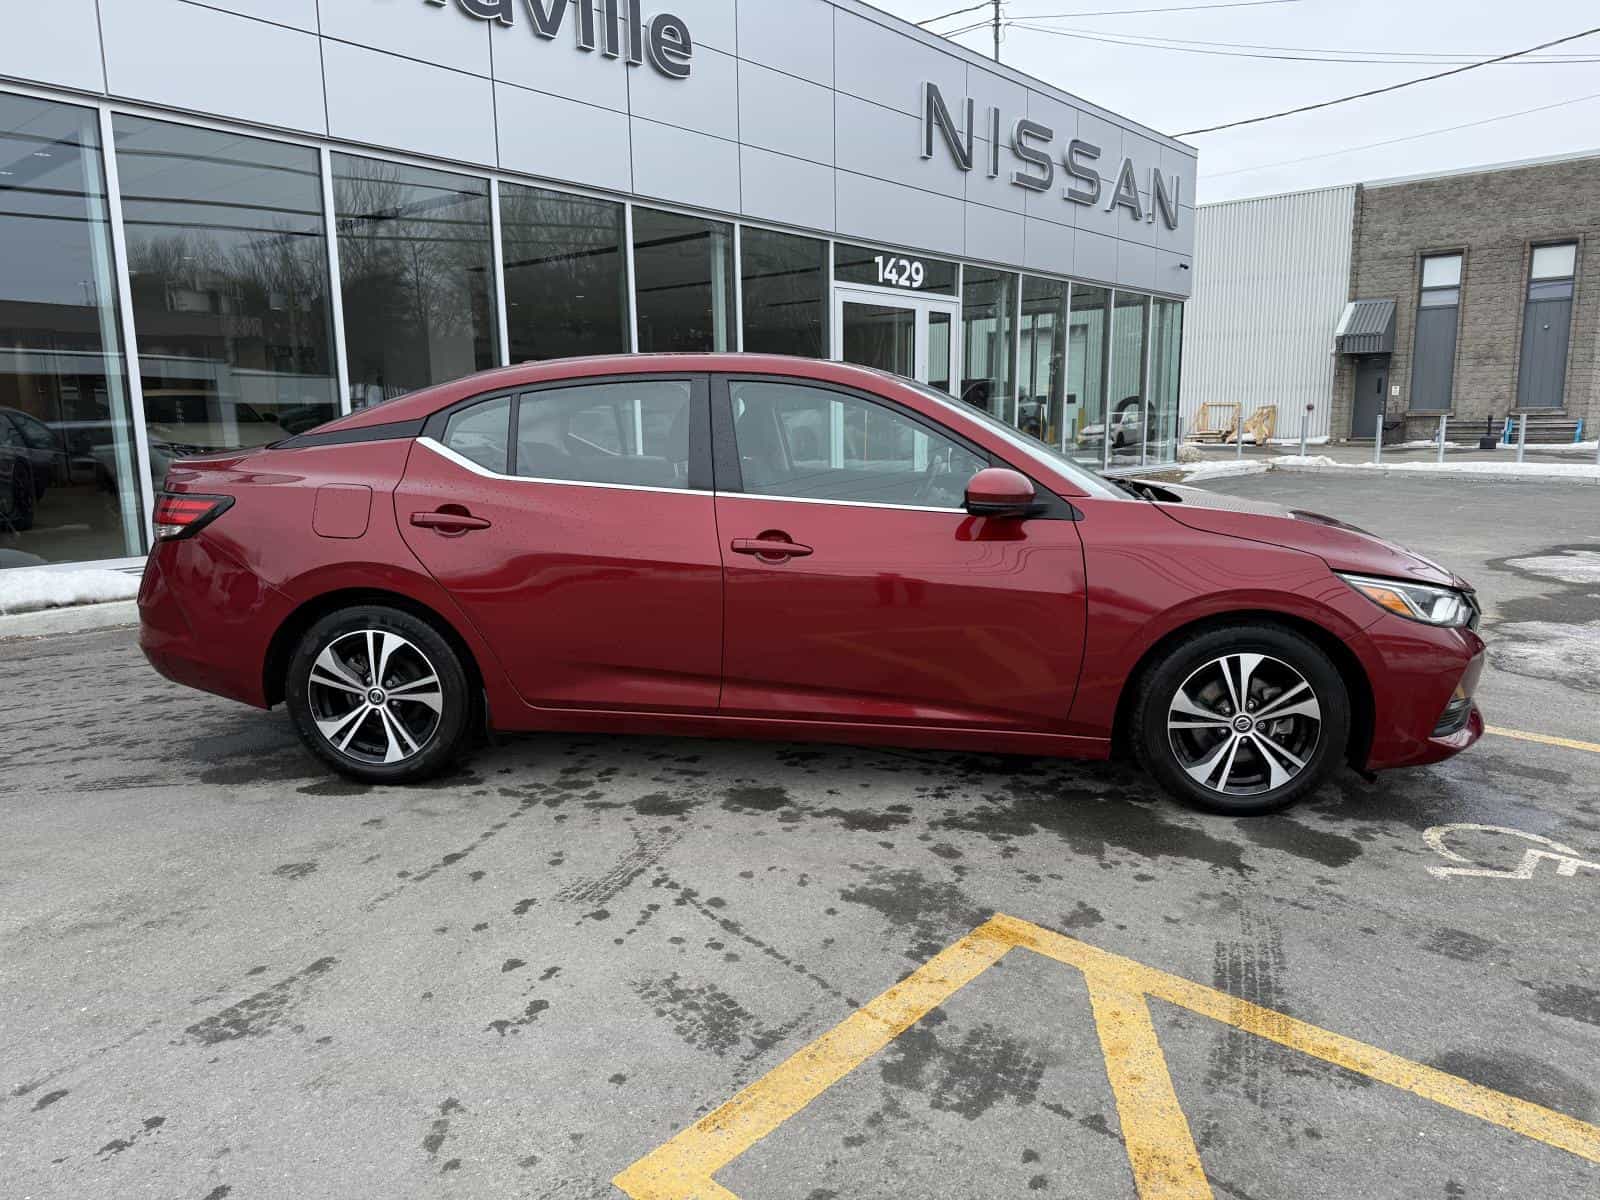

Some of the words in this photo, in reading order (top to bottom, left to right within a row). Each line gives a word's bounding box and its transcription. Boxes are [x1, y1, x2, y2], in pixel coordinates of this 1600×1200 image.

[424, 0, 692, 79] ville
[921, 80, 1180, 230] NISSAN
[874, 255, 924, 288] 1429
